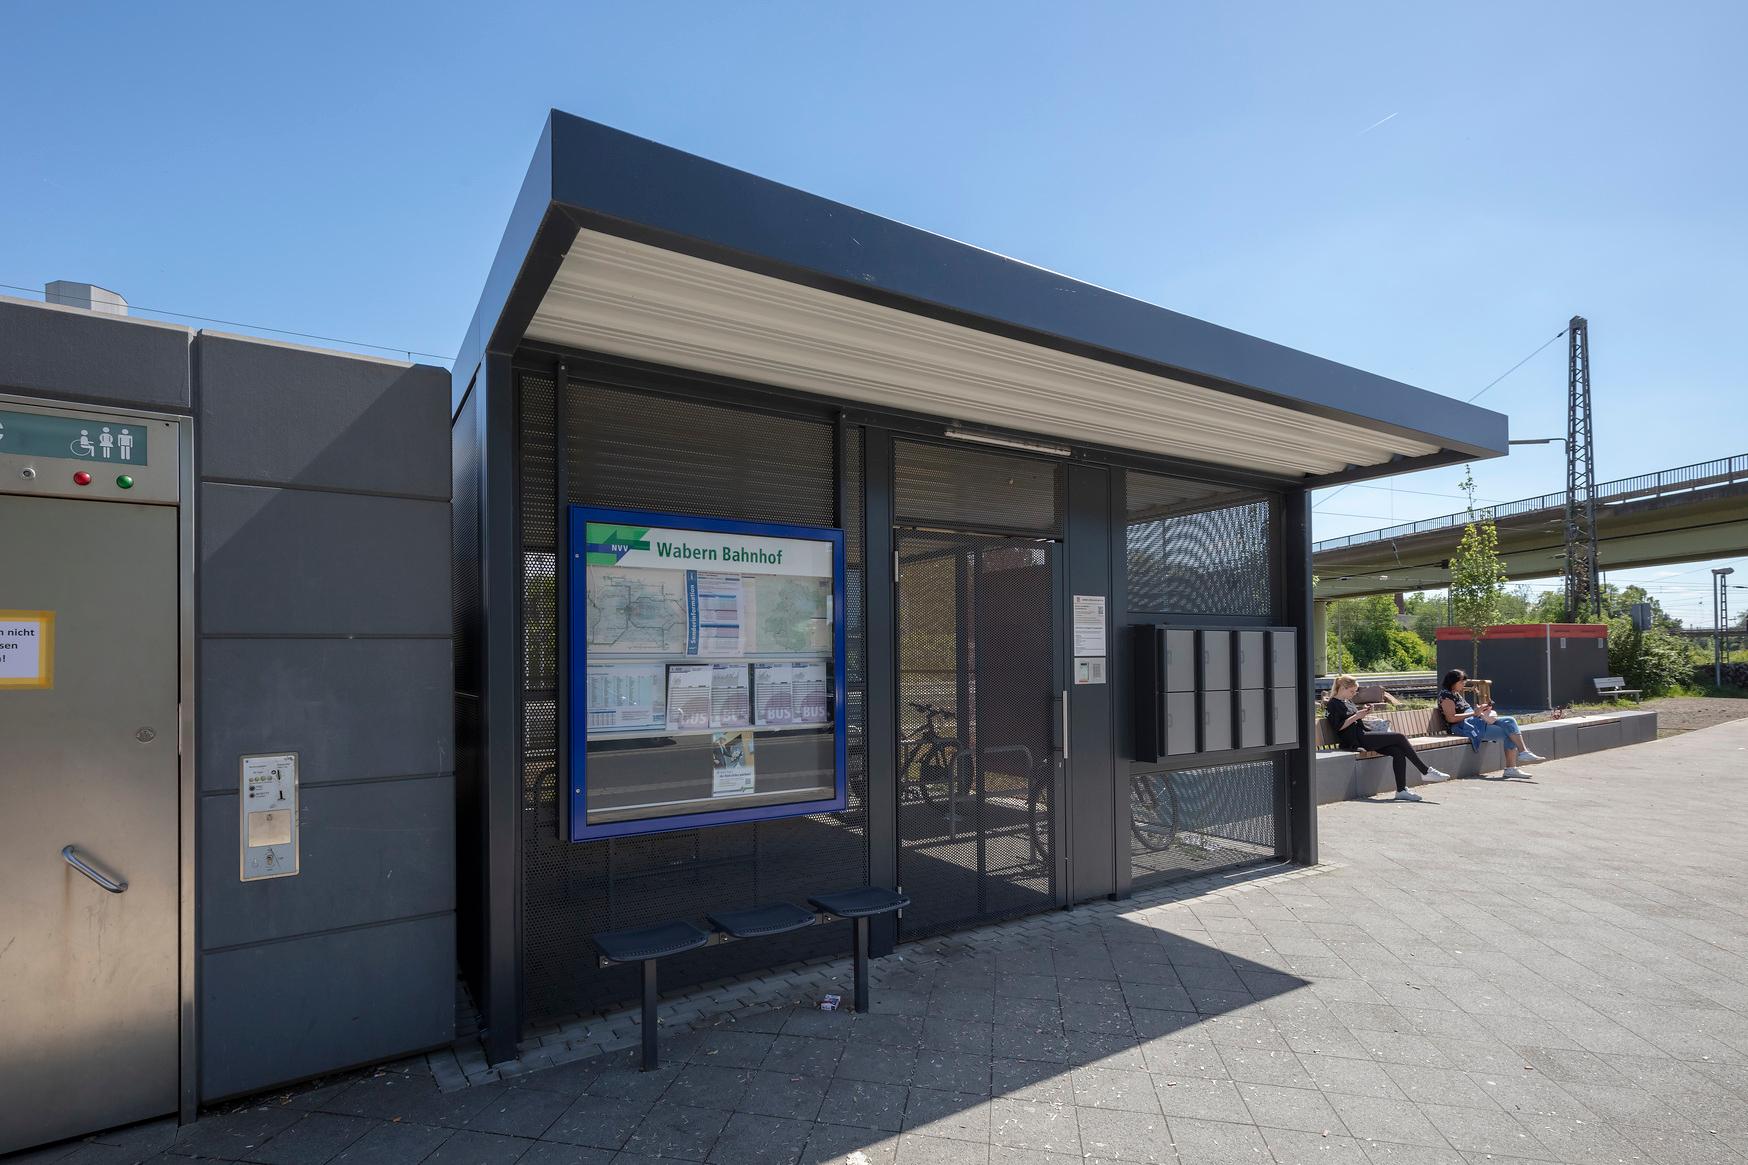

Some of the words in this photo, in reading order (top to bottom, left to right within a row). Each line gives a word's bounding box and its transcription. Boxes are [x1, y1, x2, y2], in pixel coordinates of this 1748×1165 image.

[611, 544, 629, 552] NVV
[657, 542, 717, 560] Wabern
[722, 546, 783, 565] Bahnhof
[7, 628, 35, 636] nicht
[768, 708, 792, 720] BUS
[803, 706, 825, 718] BUS
